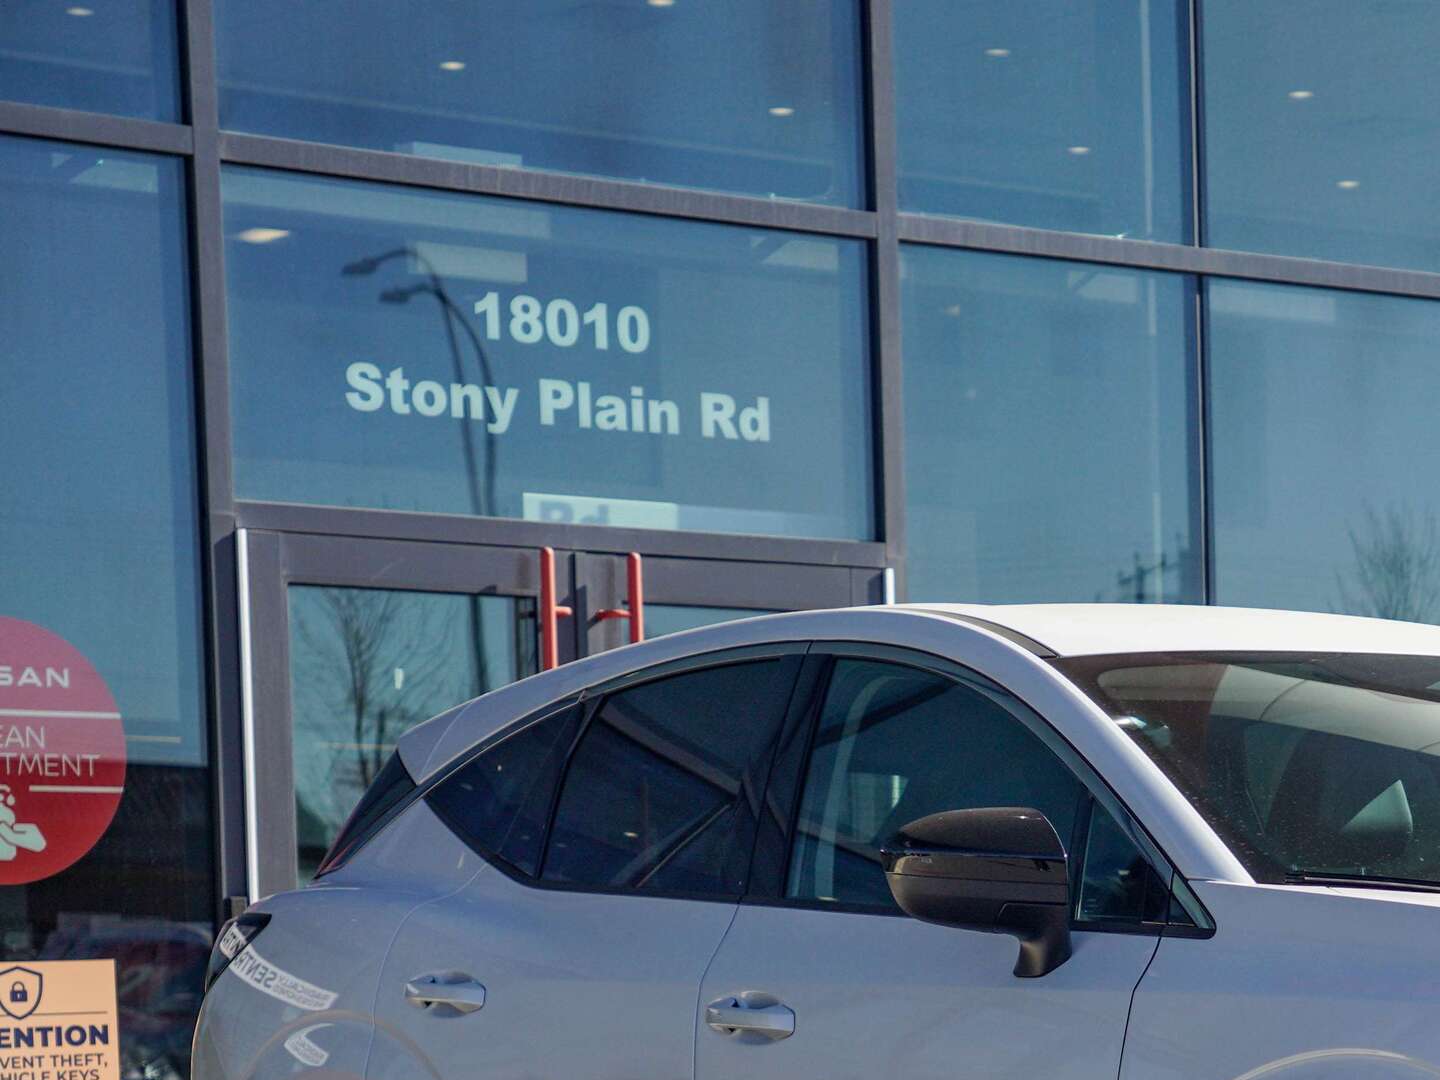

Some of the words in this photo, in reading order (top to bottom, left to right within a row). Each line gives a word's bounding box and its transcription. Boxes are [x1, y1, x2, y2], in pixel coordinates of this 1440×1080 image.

[473, 291, 651, 354] 18010
[344, 361, 519, 434] Stony
[538, 378, 681, 436] Plain
[700, 392, 771, 442] Rd
[0, 752, 100, 777] TMENT
[0, 1024, 109, 1049] ENTION
[0, 1054, 44, 1070] VENT
[50, 1053, 108, 1068] THEFT,
